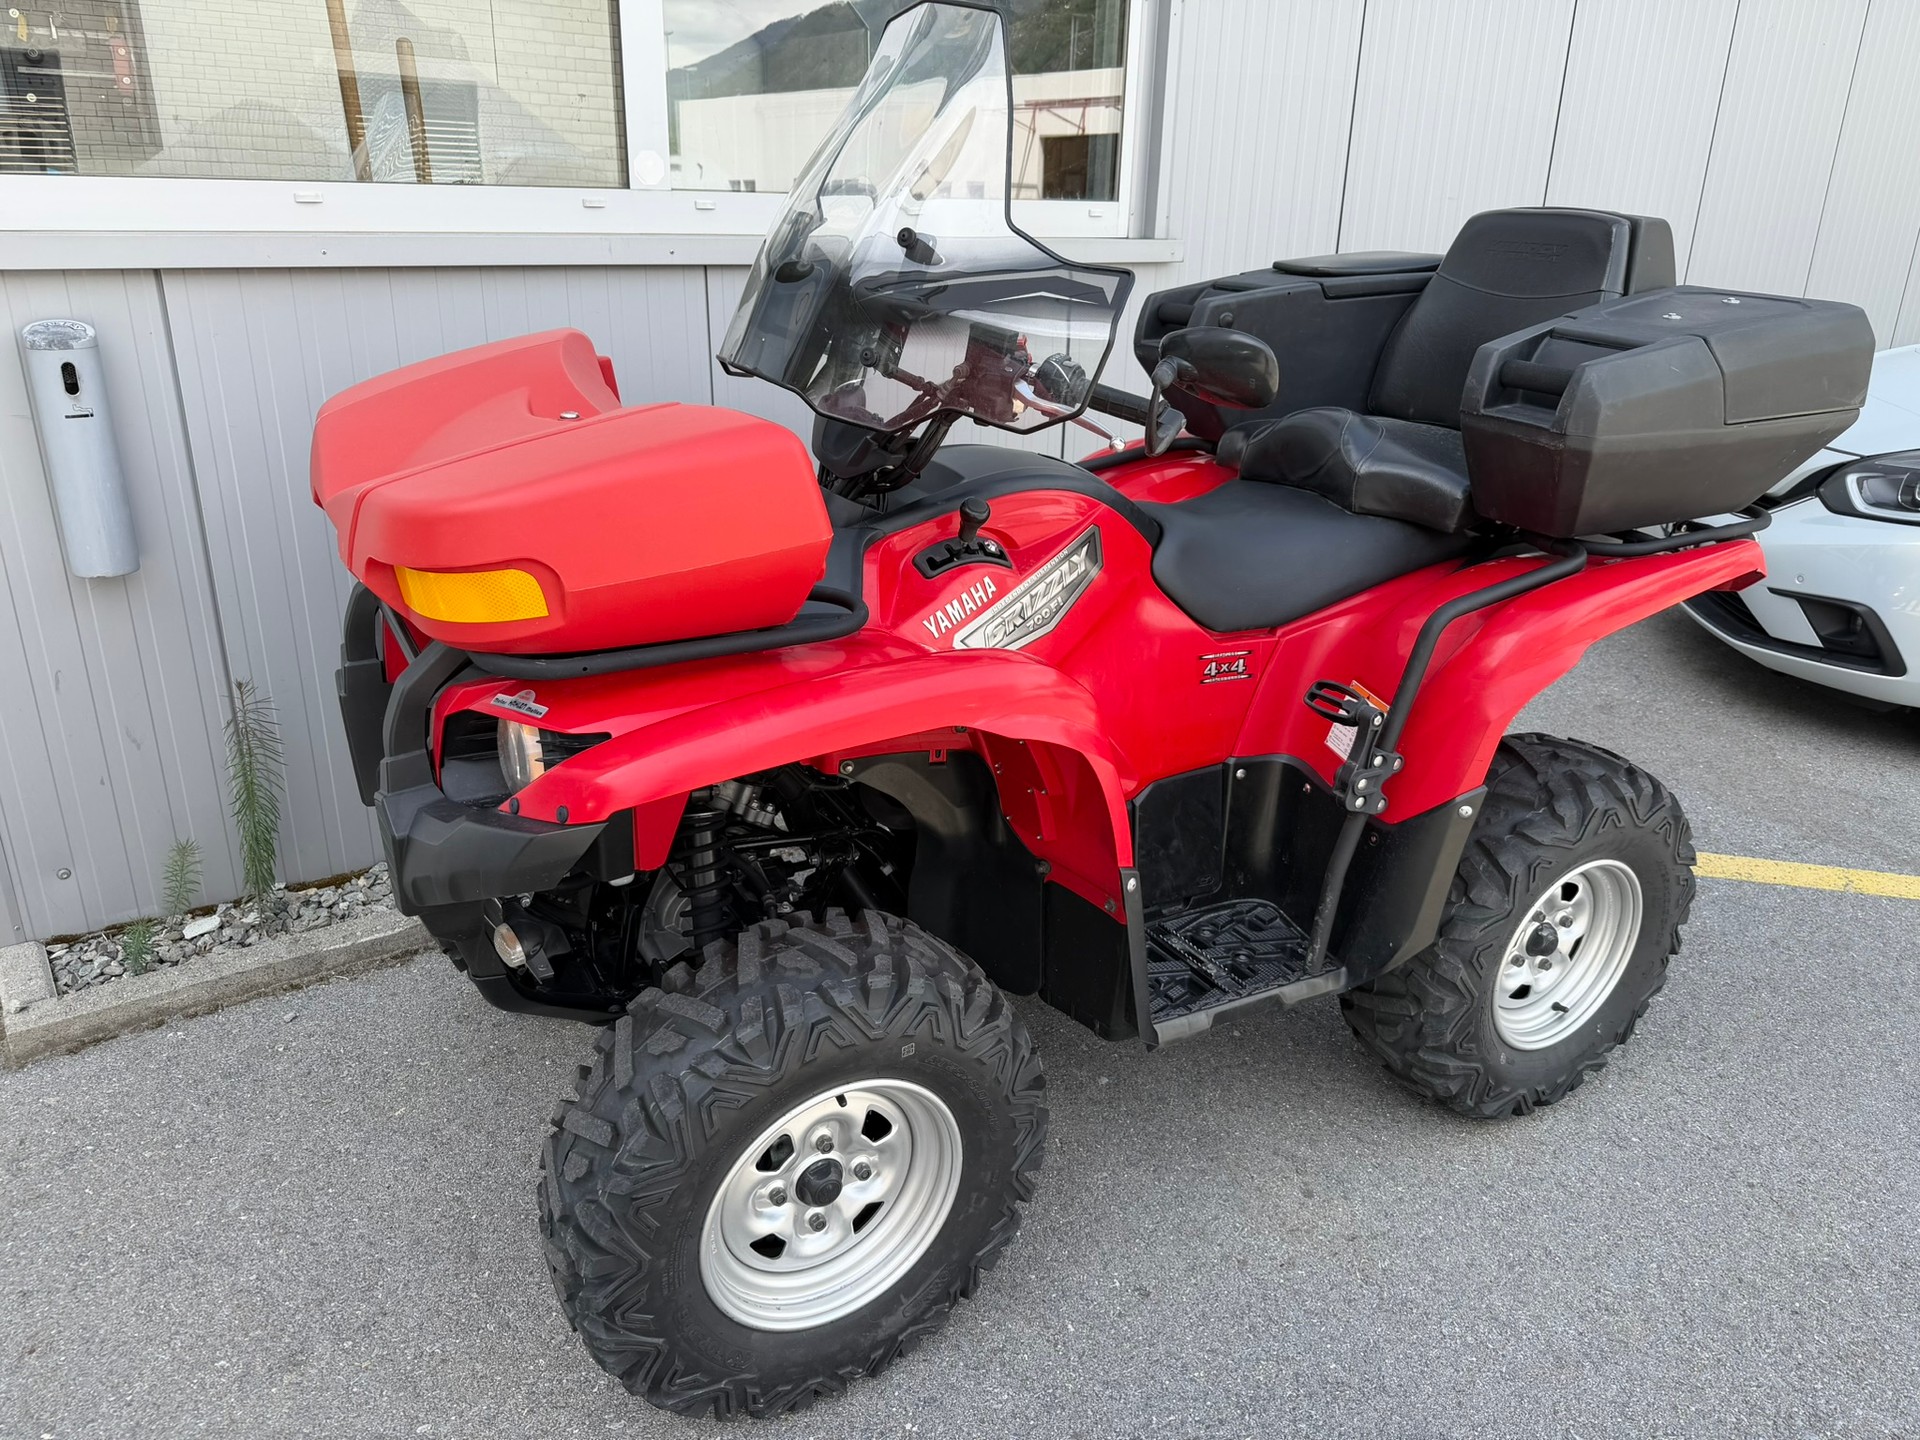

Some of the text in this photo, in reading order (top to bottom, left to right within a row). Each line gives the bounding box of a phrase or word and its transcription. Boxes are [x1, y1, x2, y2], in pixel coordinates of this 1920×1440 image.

[922, 576, 997, 639] YAMAHA
[984, 542, 1090, 648] GRIZZLY
[1203, 658, 1246, 677] 4x4
